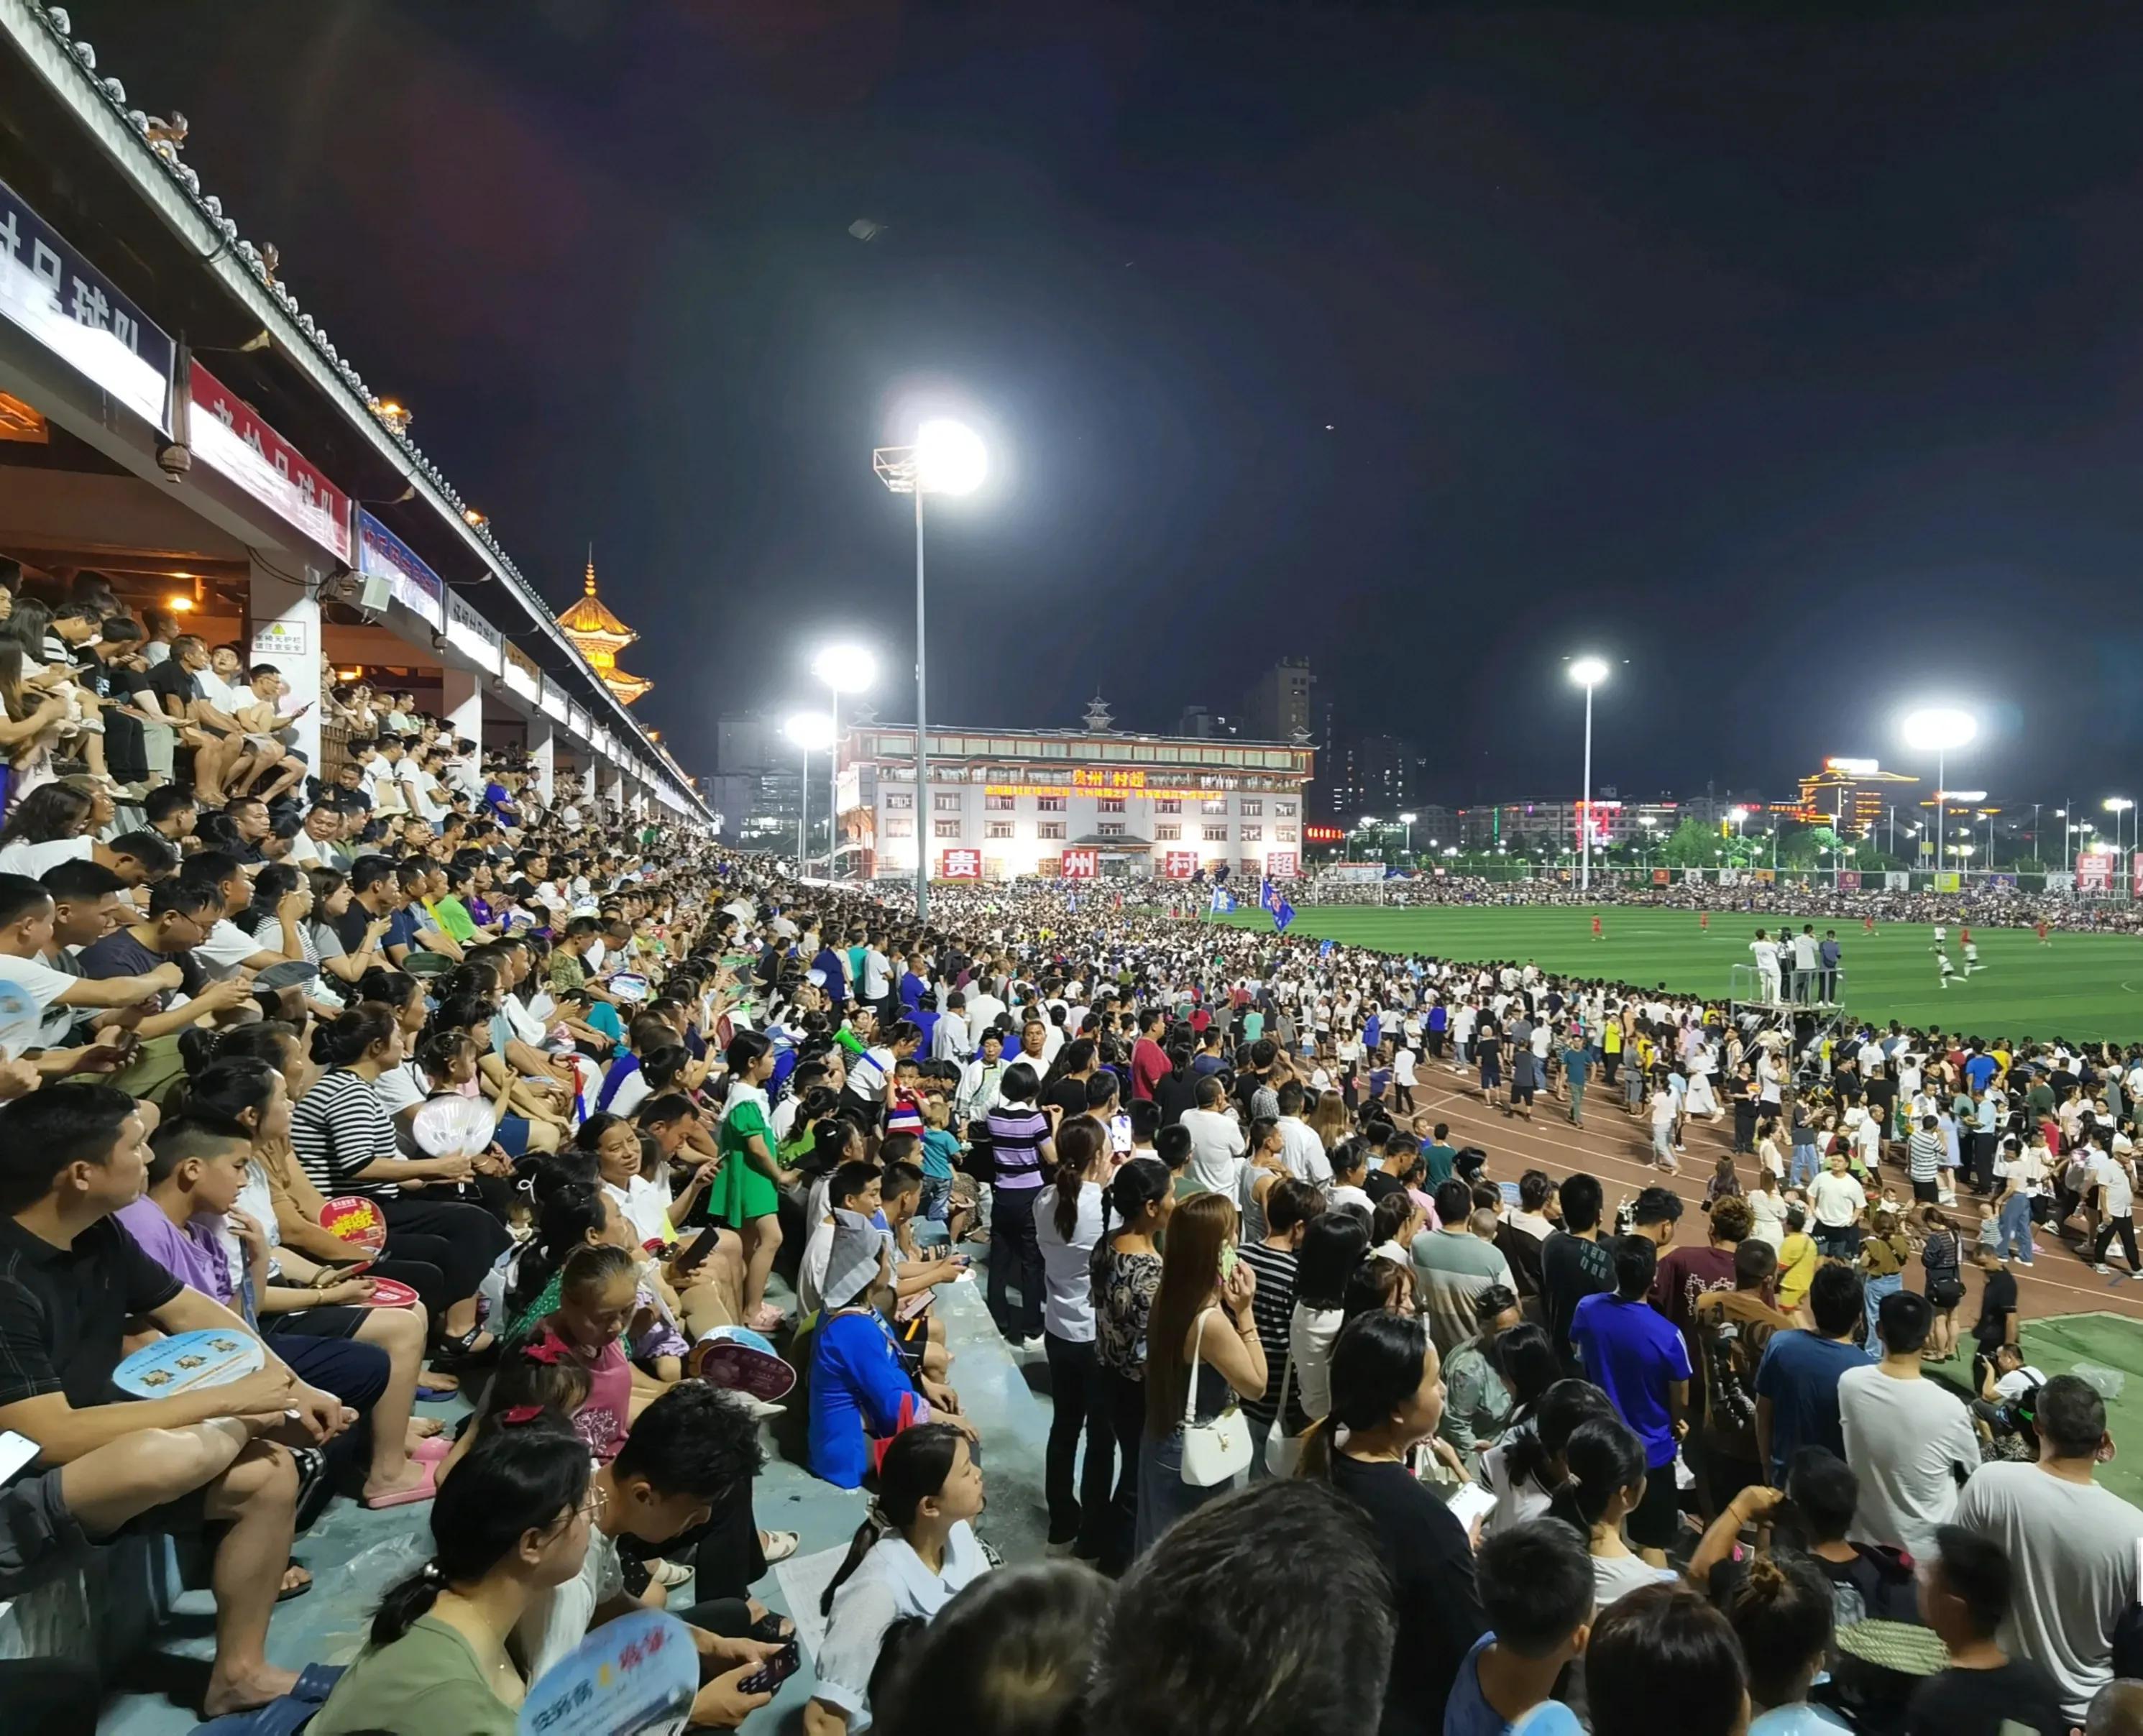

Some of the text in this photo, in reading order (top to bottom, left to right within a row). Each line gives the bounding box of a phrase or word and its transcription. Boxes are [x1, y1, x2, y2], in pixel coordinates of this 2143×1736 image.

[1073, 769, 1145, 788] 贵州 村超
[945, 850, 978, 876] 贵
[1065, 852, 1094, 876] 州
